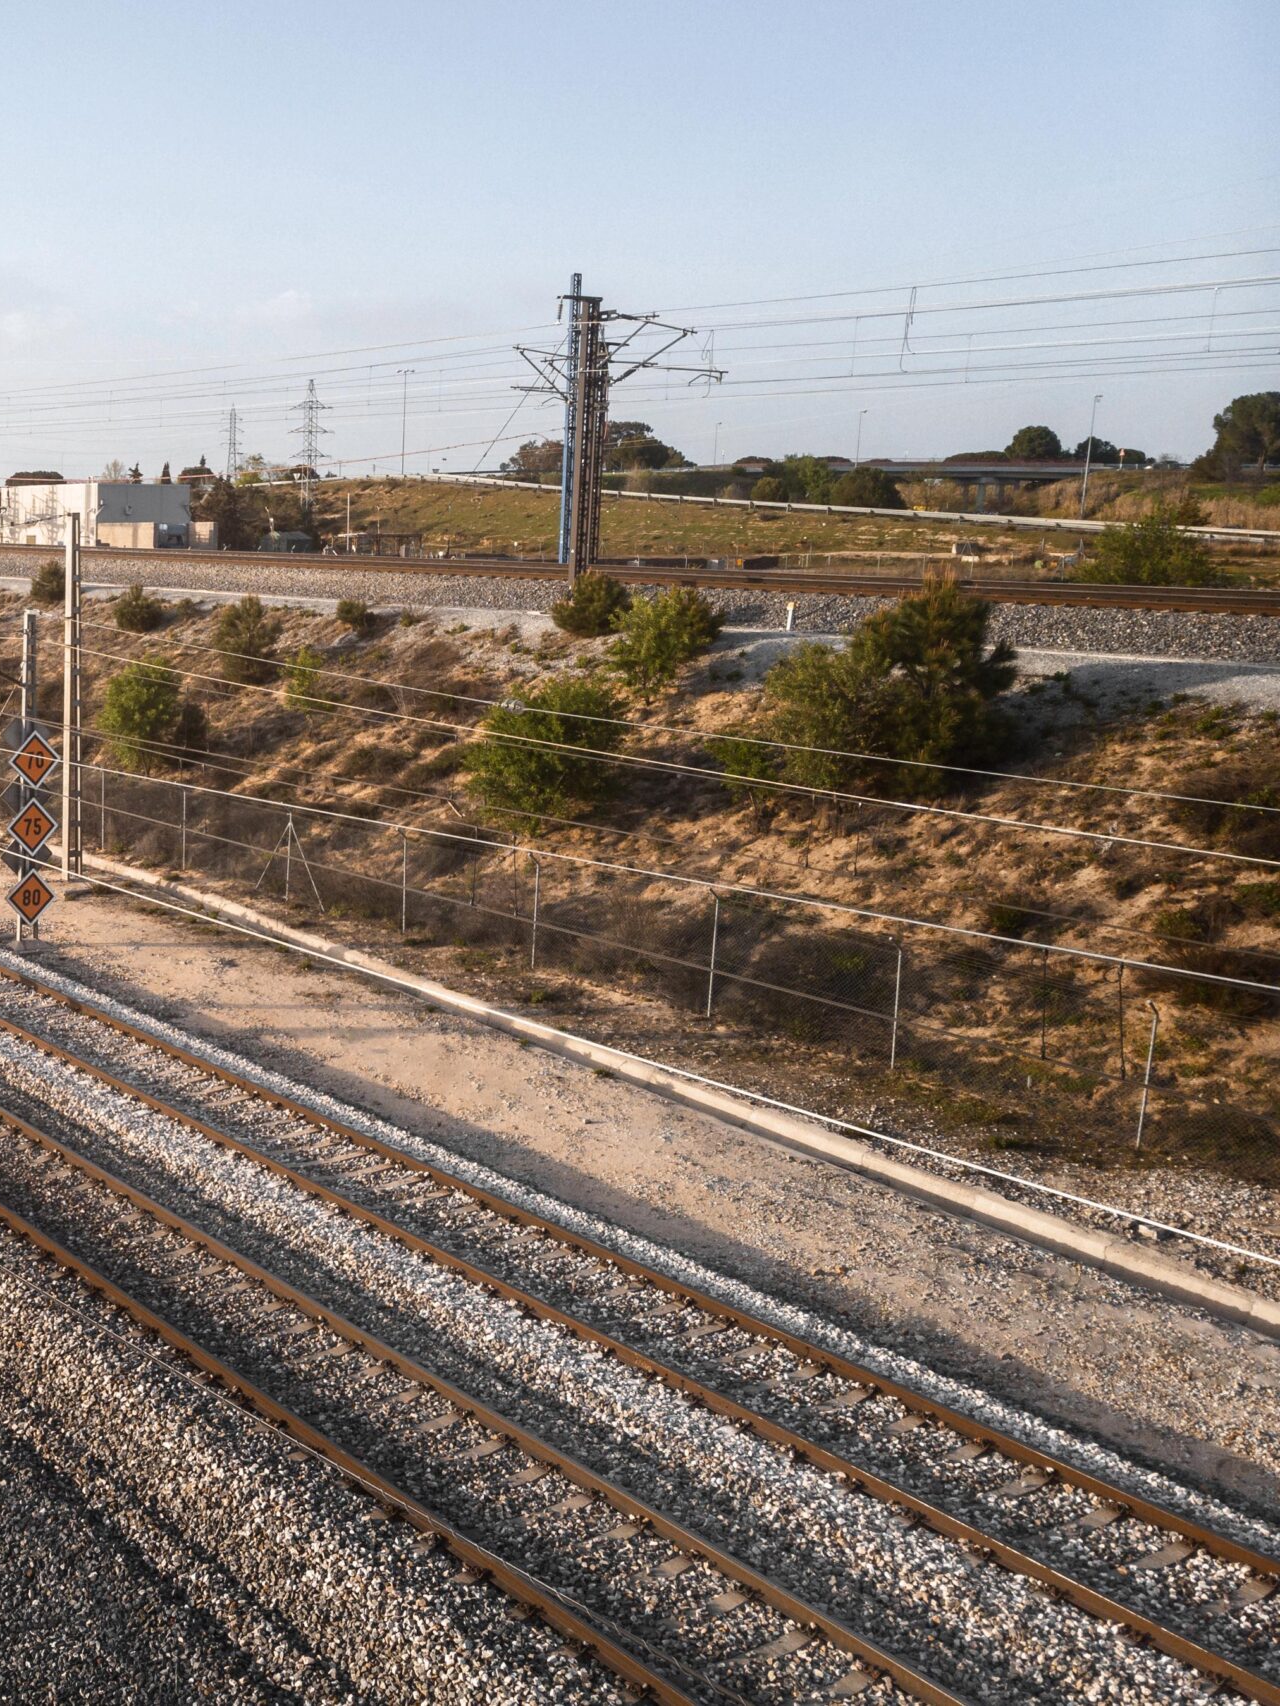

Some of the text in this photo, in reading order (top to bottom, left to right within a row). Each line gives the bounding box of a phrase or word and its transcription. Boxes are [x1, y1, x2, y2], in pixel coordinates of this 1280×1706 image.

[26, 752, 44, 769] 70
[23, 817, 42, 836] 75
[22, 889, 41, 906] 80
